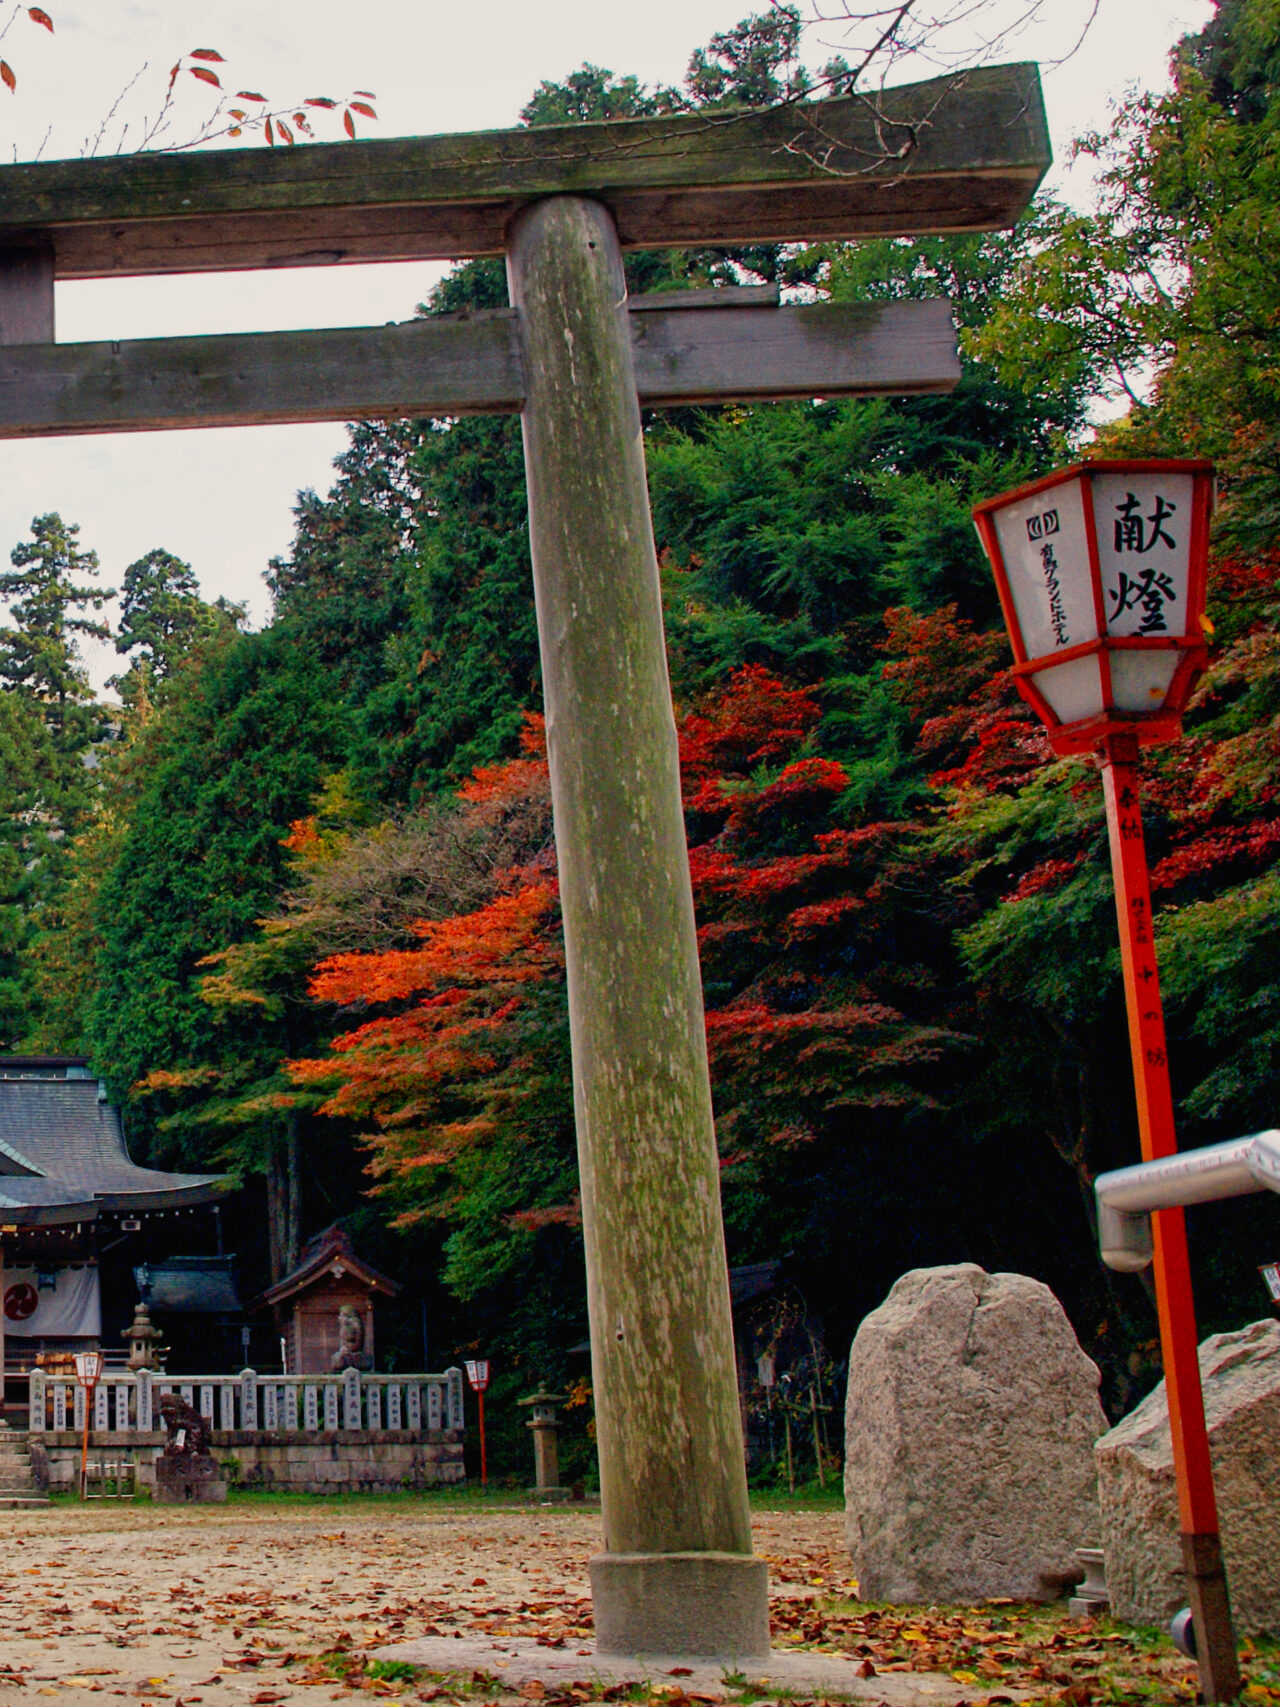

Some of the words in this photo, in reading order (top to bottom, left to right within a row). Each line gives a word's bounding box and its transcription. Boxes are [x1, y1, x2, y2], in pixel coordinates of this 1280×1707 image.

[1039, 542, 1070, 647] 有馬グランドホテル
[1108, 492, 1177, 632] 献燈
